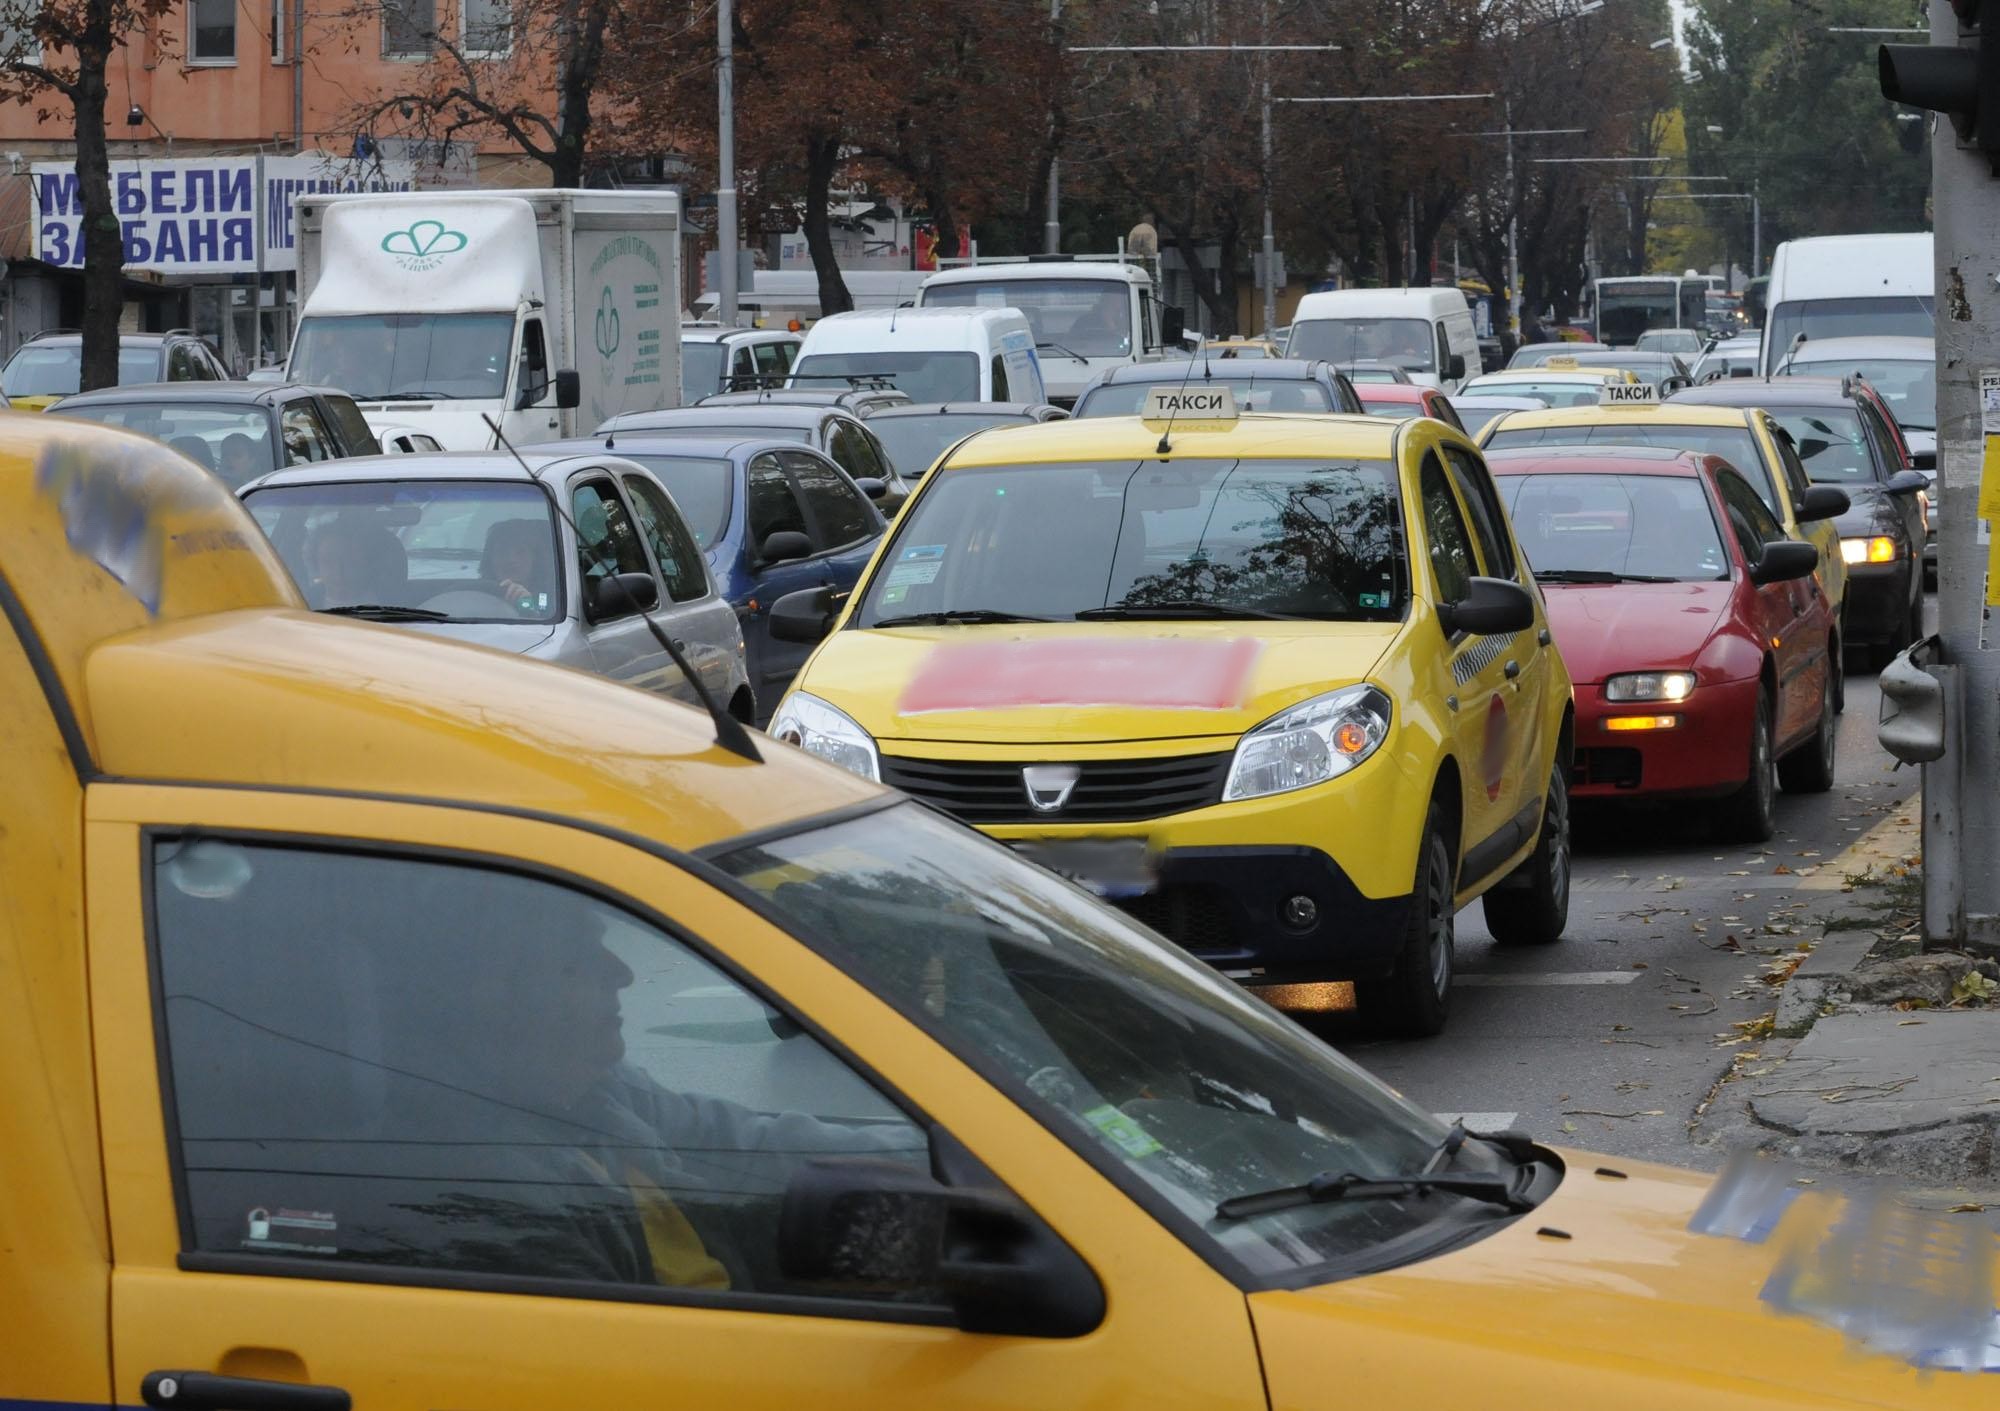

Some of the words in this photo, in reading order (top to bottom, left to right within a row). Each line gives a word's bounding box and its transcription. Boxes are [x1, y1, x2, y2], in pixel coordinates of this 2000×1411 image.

[42, 168, 252, 217] МБЕЛИ
[122, 217, 253, 264] БАНЯ
[1156, 395, 1222, 410] ТАКСИ
[1608, 386, 1652, 400] ТАКСИ
